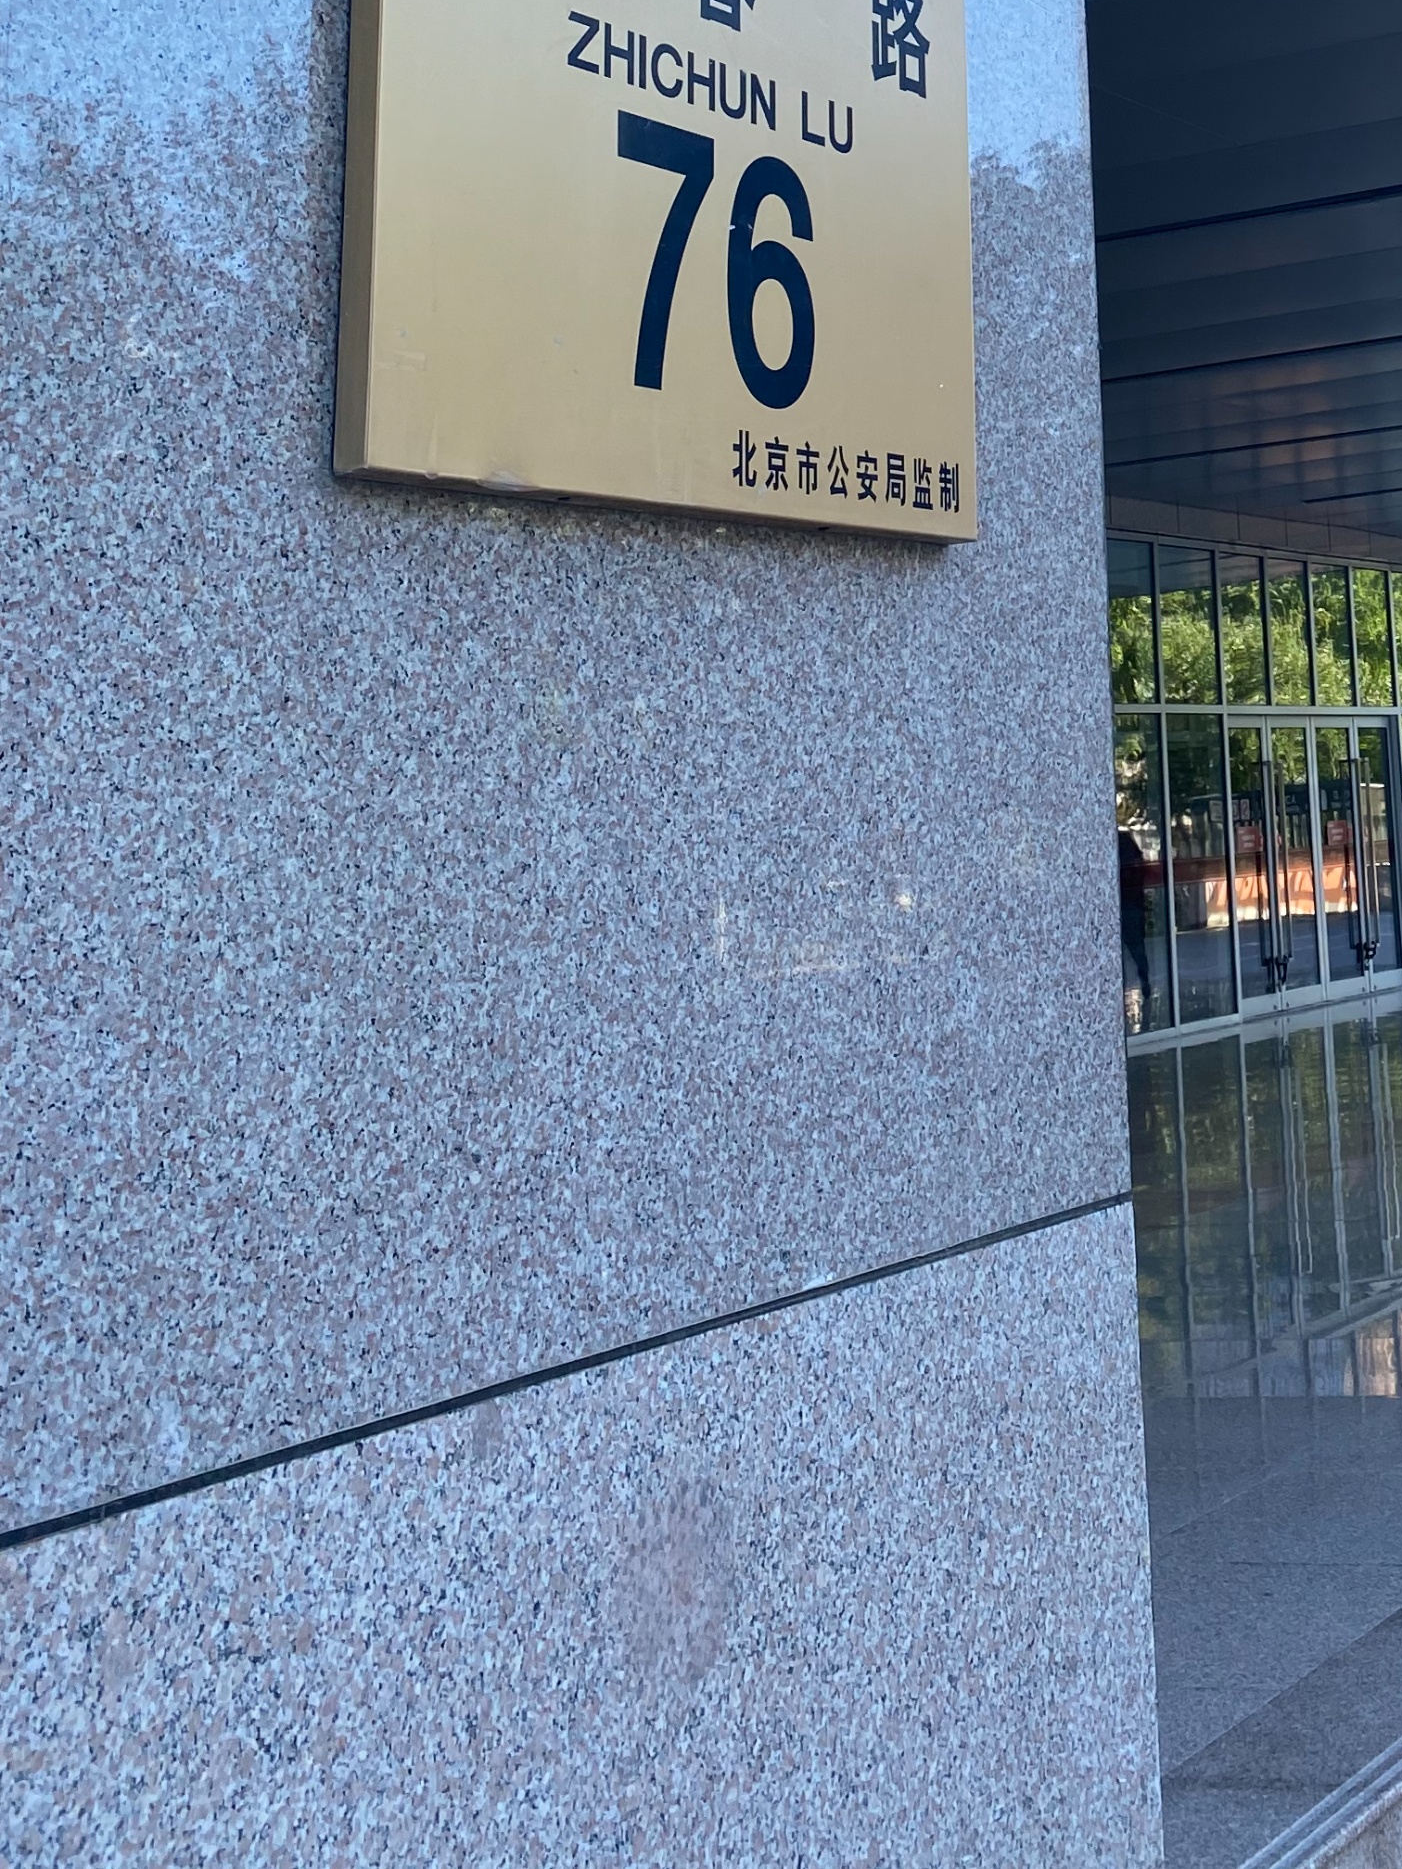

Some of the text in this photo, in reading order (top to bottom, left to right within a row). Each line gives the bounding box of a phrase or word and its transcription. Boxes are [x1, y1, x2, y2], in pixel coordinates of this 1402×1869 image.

[567, 10, 854, 154] ZHICHUN LU
[617, 109, 815, 410] 76
[732, 429, 960, 513] 北京市公安局监制
